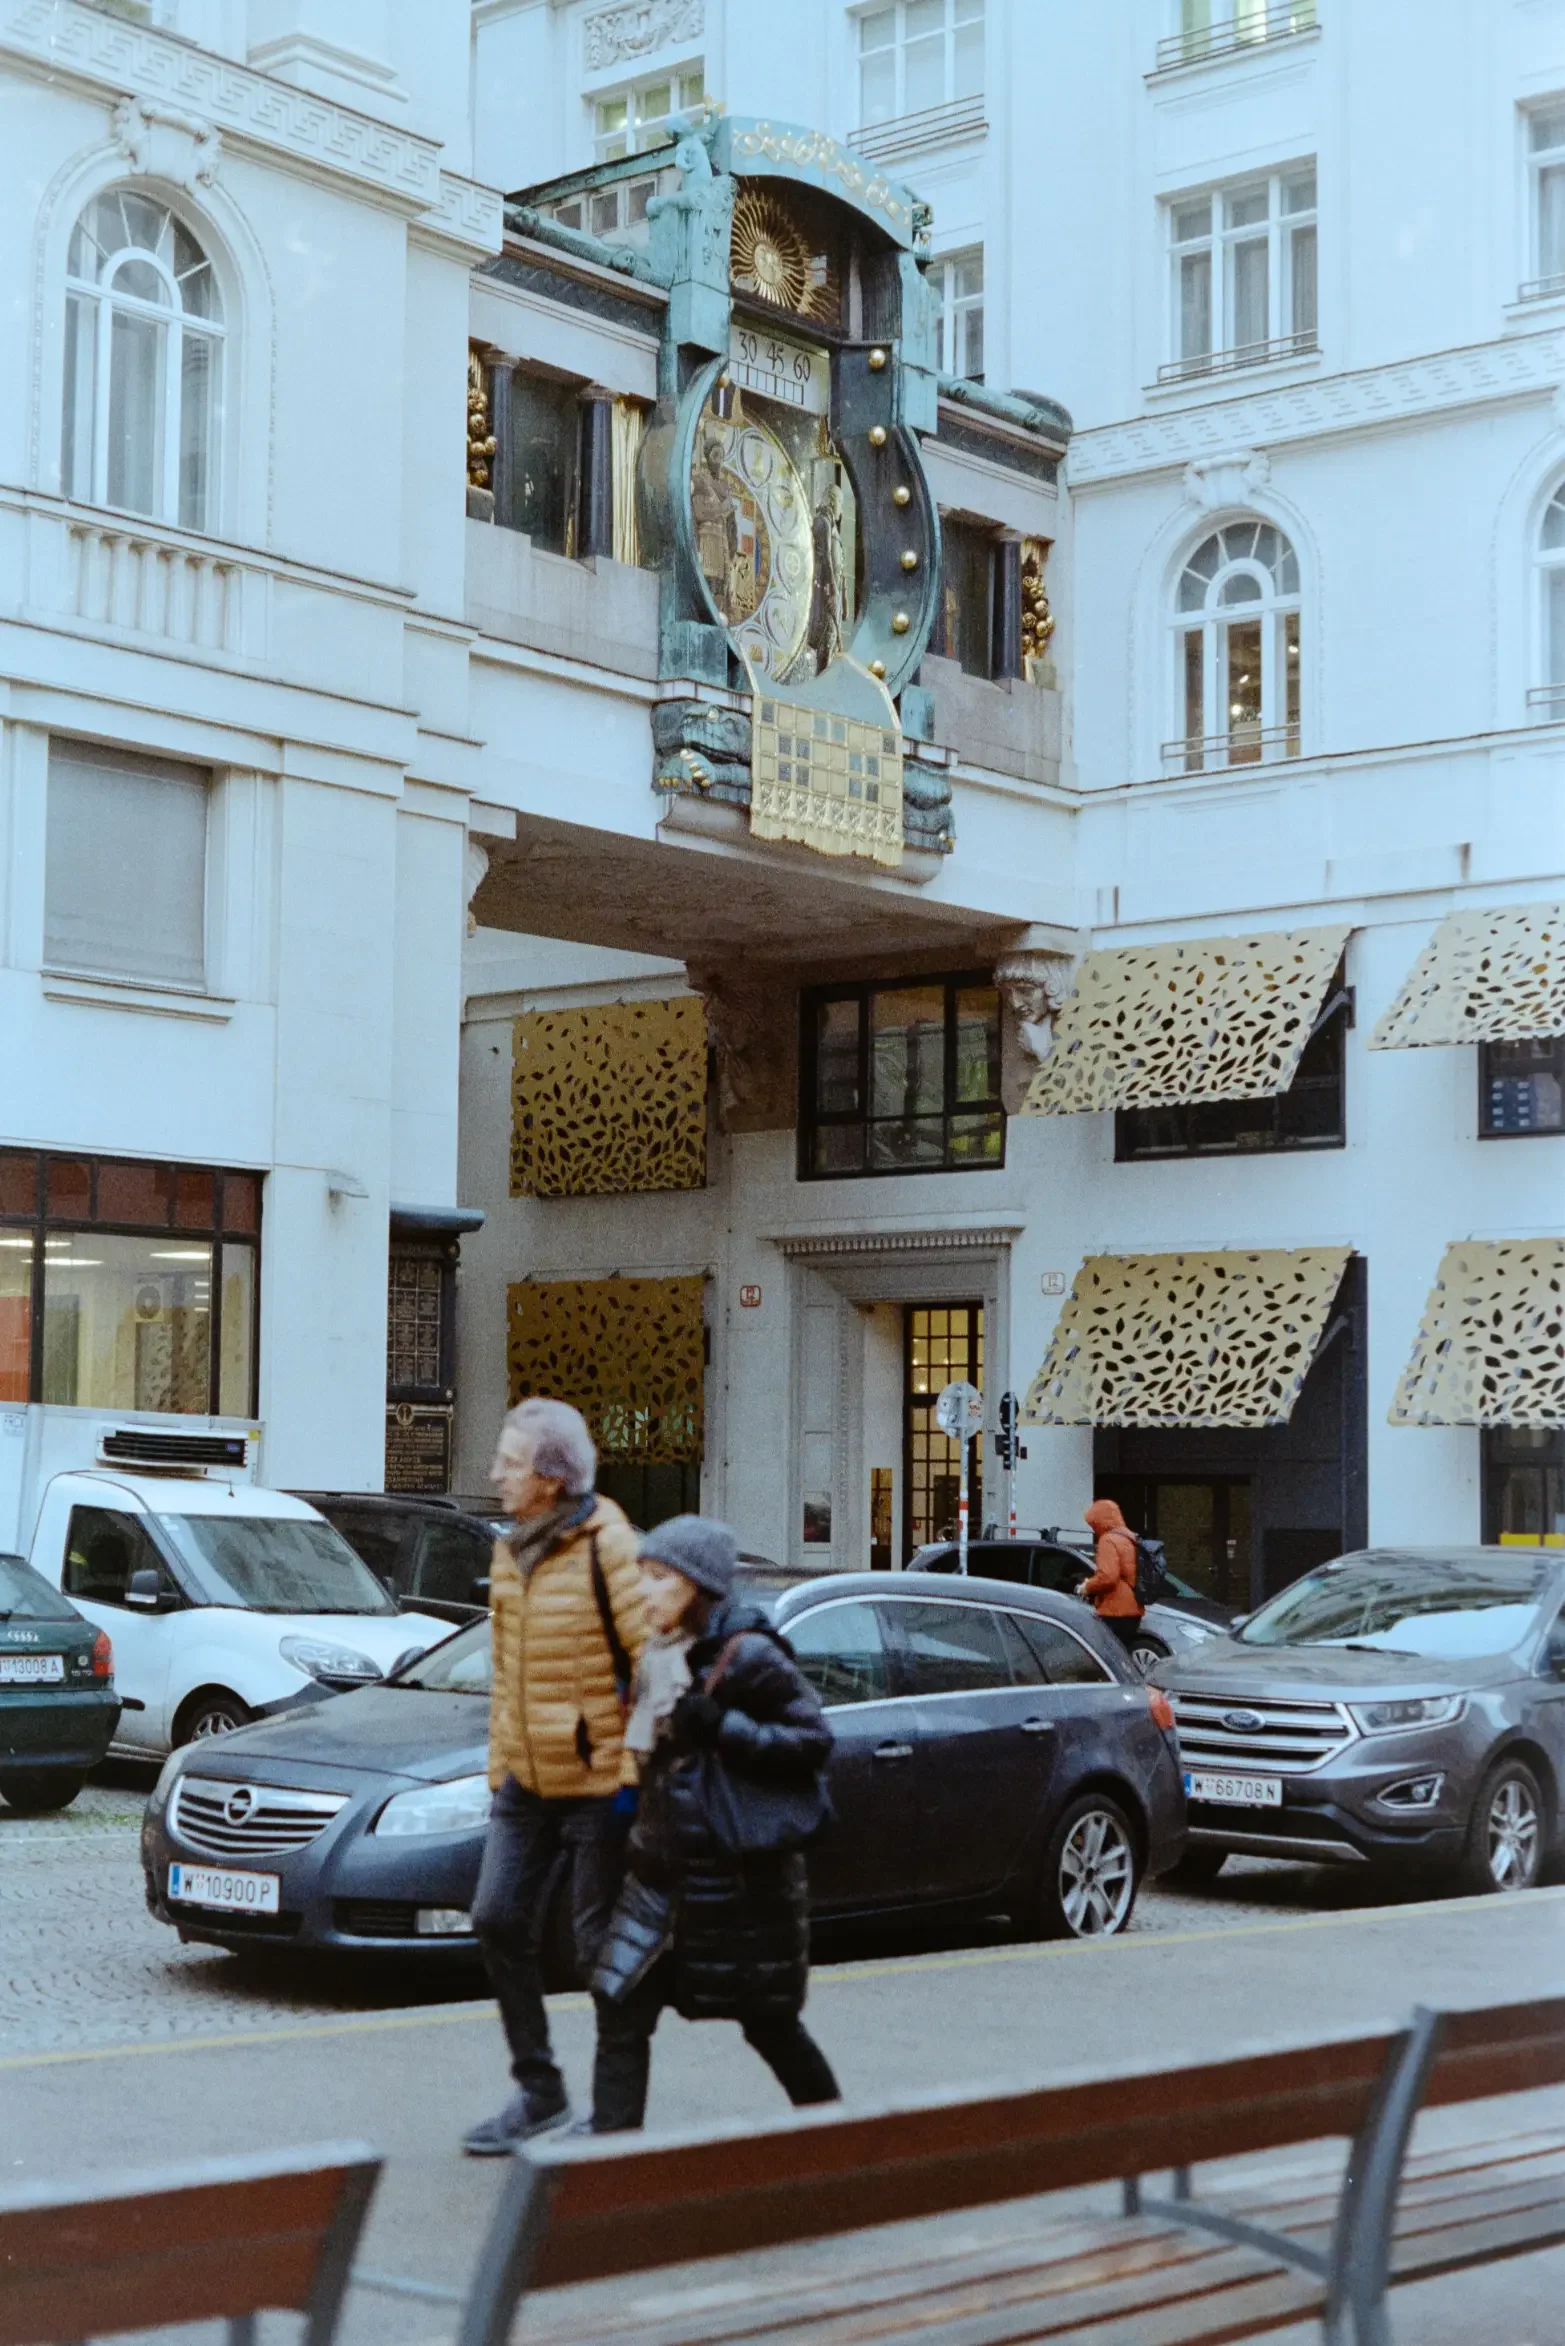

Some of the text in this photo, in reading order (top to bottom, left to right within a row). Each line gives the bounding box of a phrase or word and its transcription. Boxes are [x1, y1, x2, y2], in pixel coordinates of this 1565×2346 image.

[739, 331, 811, 383] 30 45 60
[51, 1658, 60, 1674] A
[1194, 1777, 1275, 1801] W 66708 N
[183, 1872, 194, 1893] W
[206, 1875, 256, 1903] 10900
[260, 1881, 271, 1904] P
